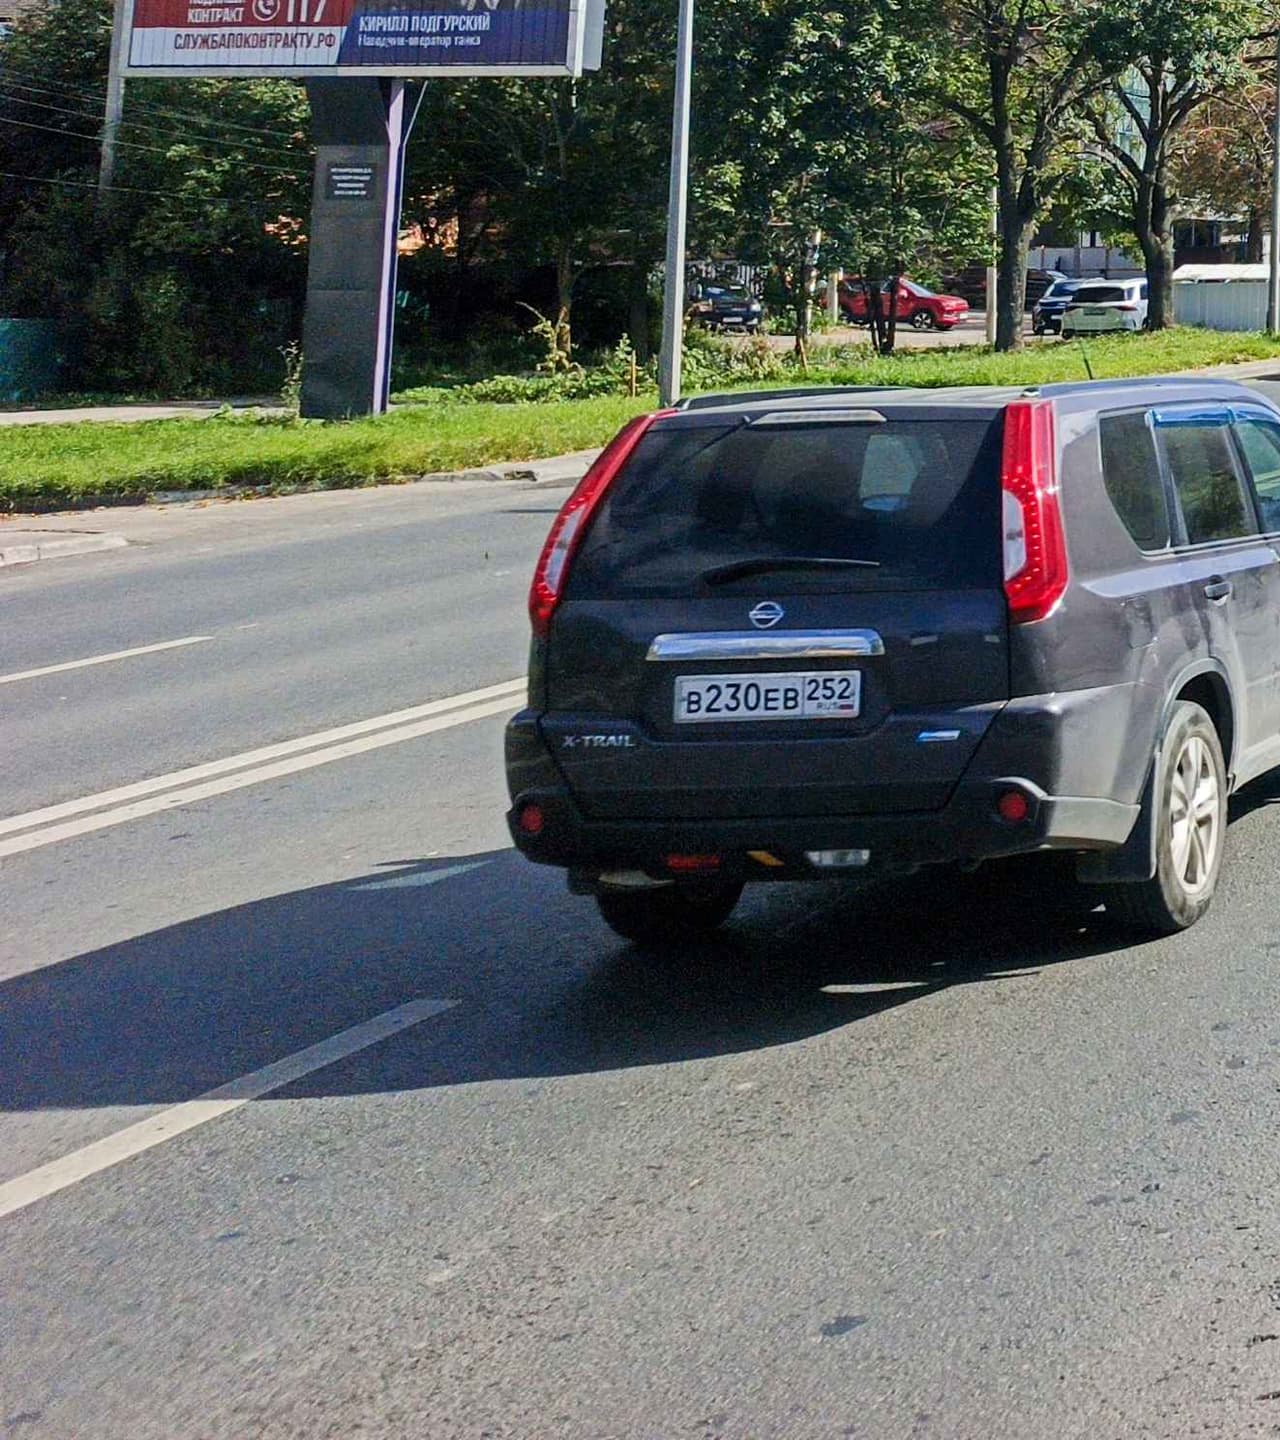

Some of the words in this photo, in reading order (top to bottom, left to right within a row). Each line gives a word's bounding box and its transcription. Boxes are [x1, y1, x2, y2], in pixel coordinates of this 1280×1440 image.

[187, 7, 245, 23] КОНТРАКТ
[359, 15, 409, 31] КИРИЛЛ
[411, 12, 491, 33] ПОДГУРСКИЙ
[174, 32, 336, 50] СЛУЖБАПОКОНТРАКТУ.РФ
[806, 677, 852, 702] 252
[562, 735, 636, 748] X-TRAIL
